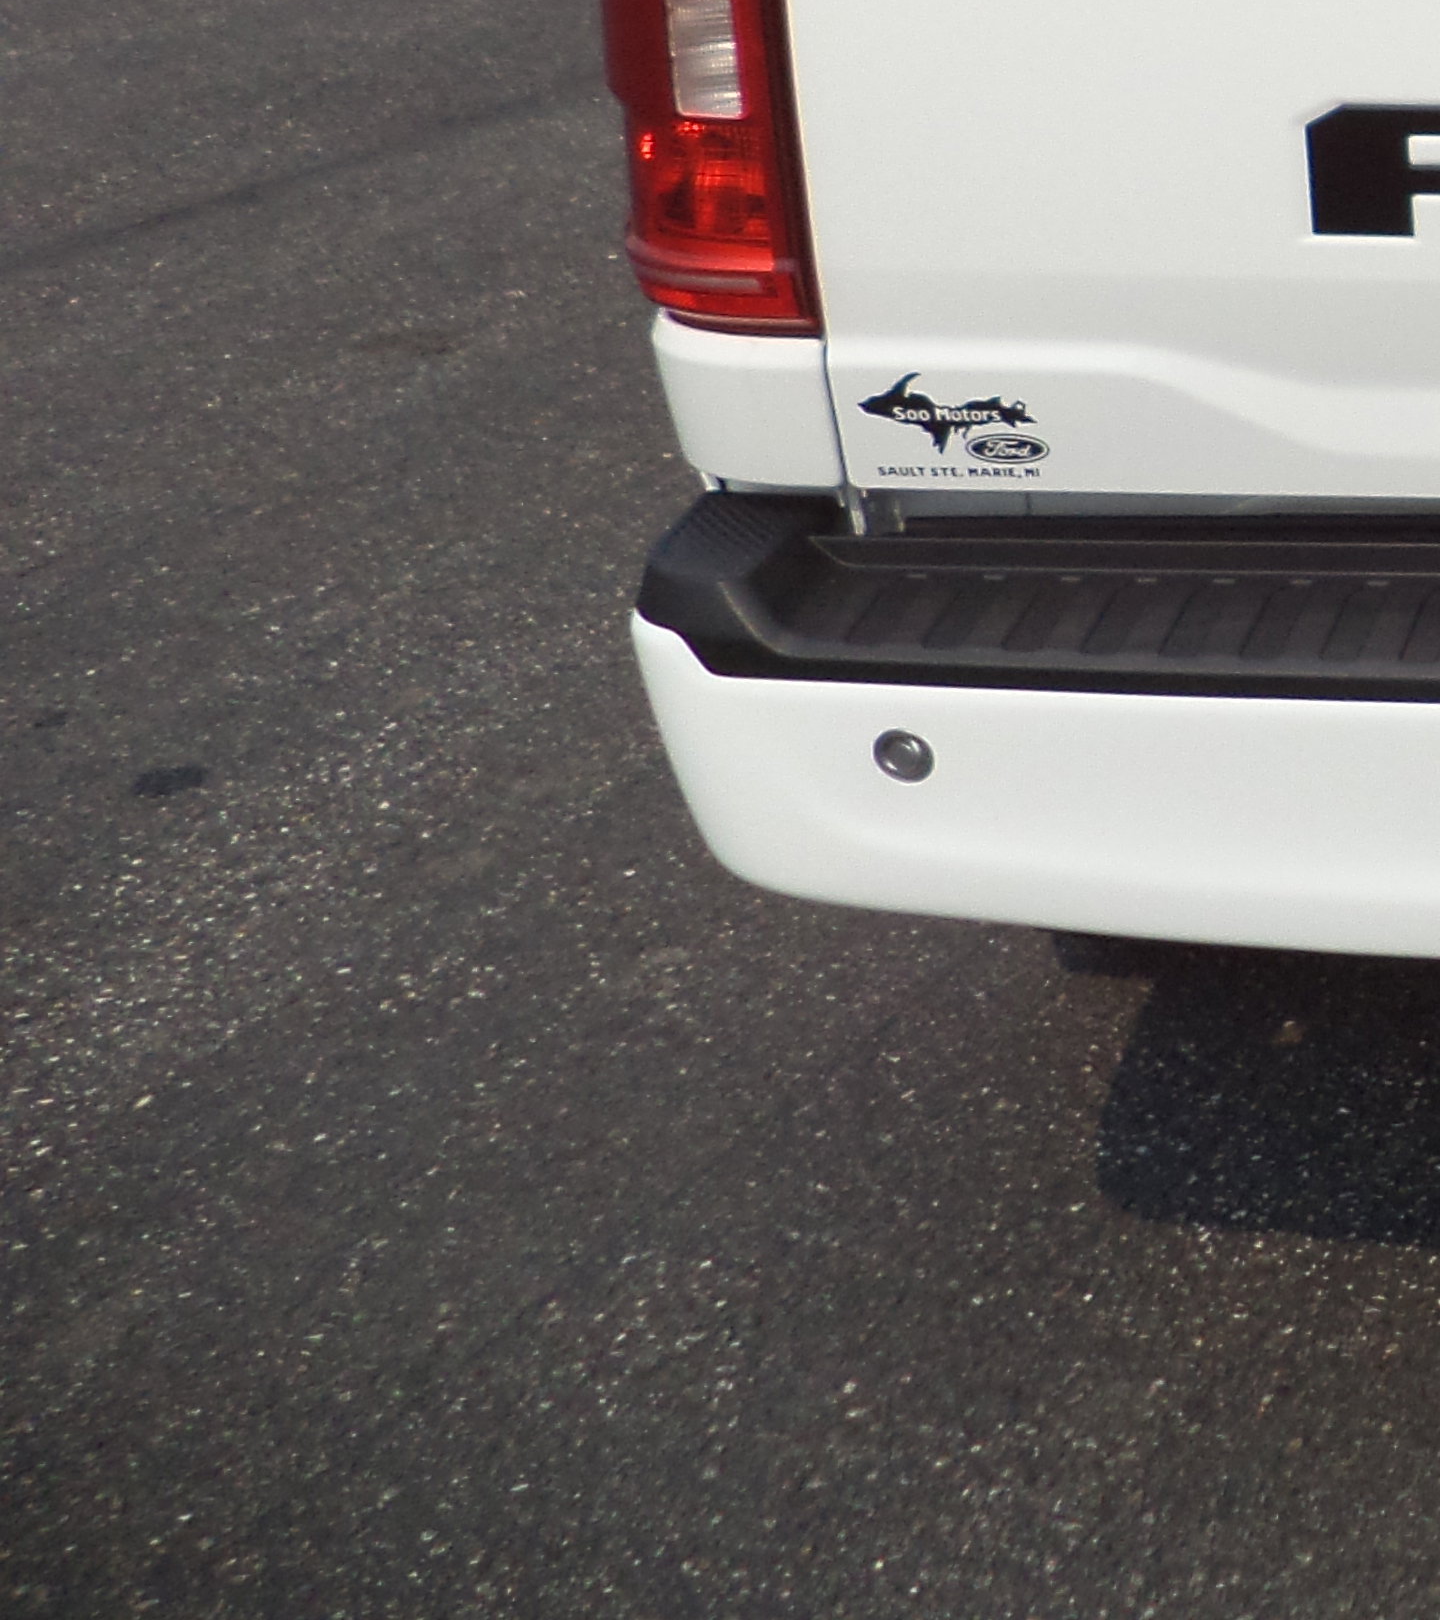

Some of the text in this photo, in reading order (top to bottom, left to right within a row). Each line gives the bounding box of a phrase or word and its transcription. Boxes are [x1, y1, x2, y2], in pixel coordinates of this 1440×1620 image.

[892, 406, 1001, 422] Soo Motors
[984, 437, 1031, 458] Ford
[877, 465, 925, 477] SAULT
[931, 465, 964, 477] STE.
[1025, 466, 1040, 478] MI
